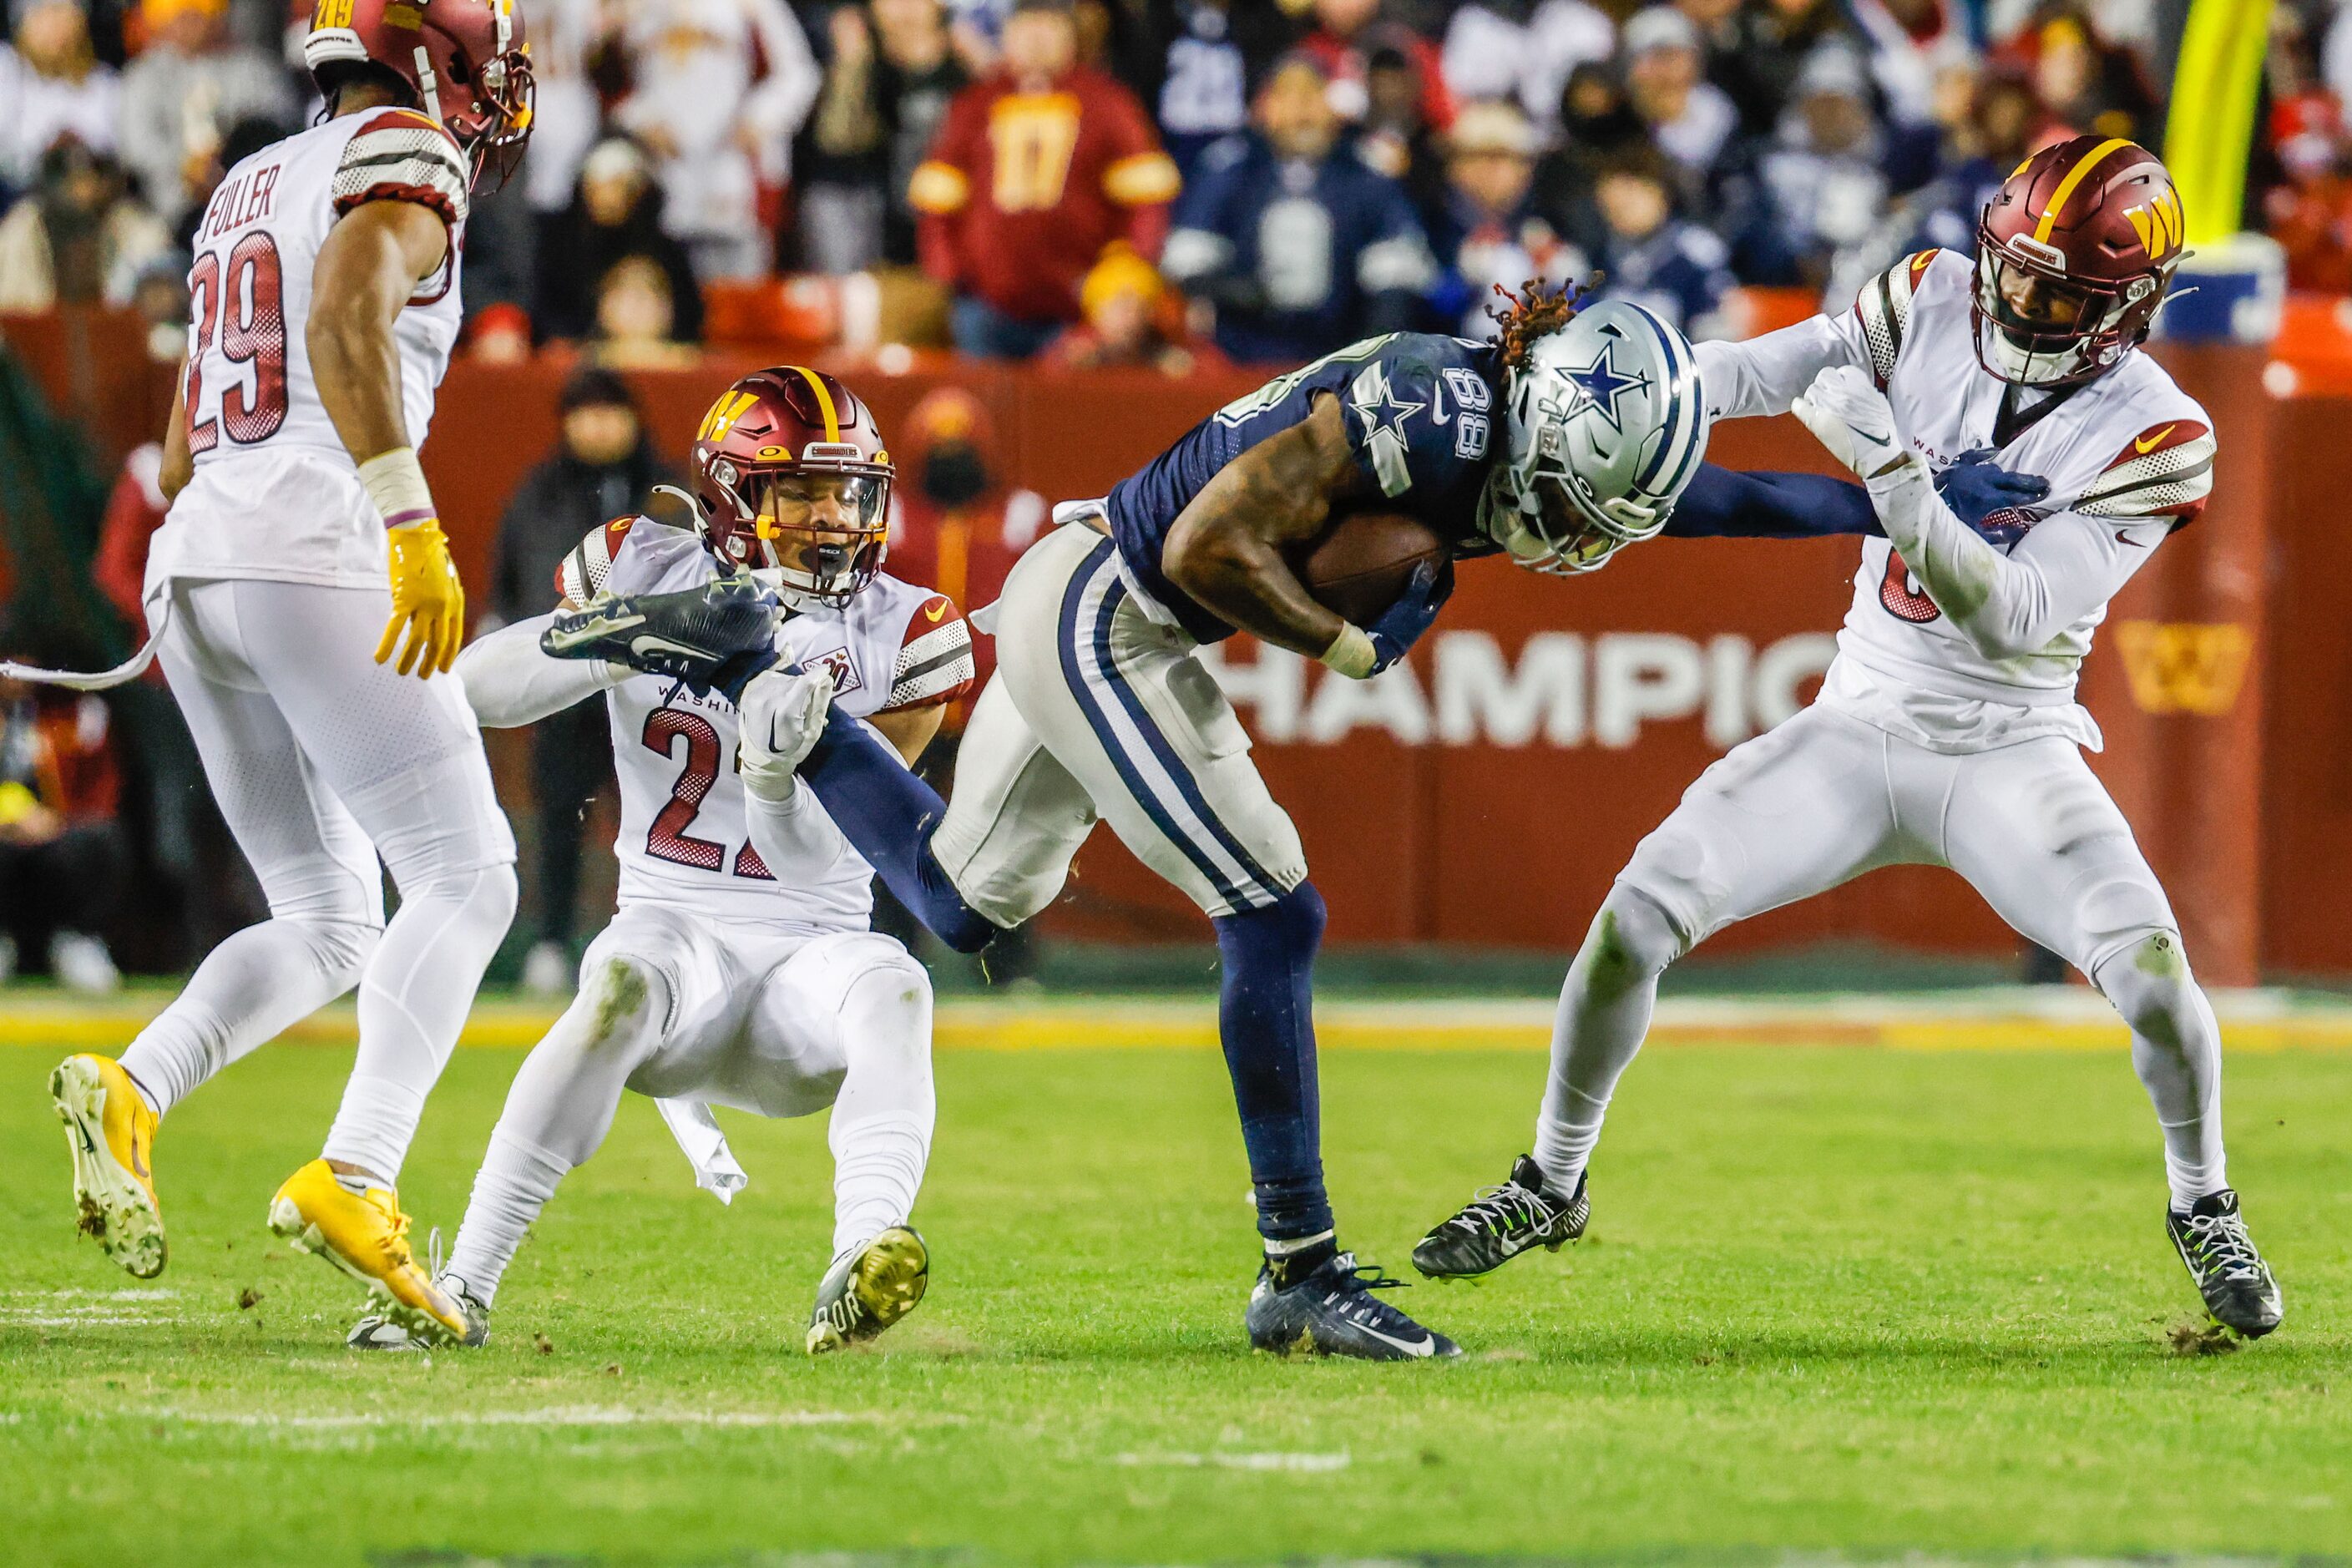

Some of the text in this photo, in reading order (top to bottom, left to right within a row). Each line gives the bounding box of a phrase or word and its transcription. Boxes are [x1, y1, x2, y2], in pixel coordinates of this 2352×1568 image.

[200, 163, 281, 245] FULLER
[186, 229, 289, 453] 29
[1442, 367, 1492, 461] 88
[1913, 436, 1950, 466] WAS
[1189, 631, 1840, 746] HAMPIO
